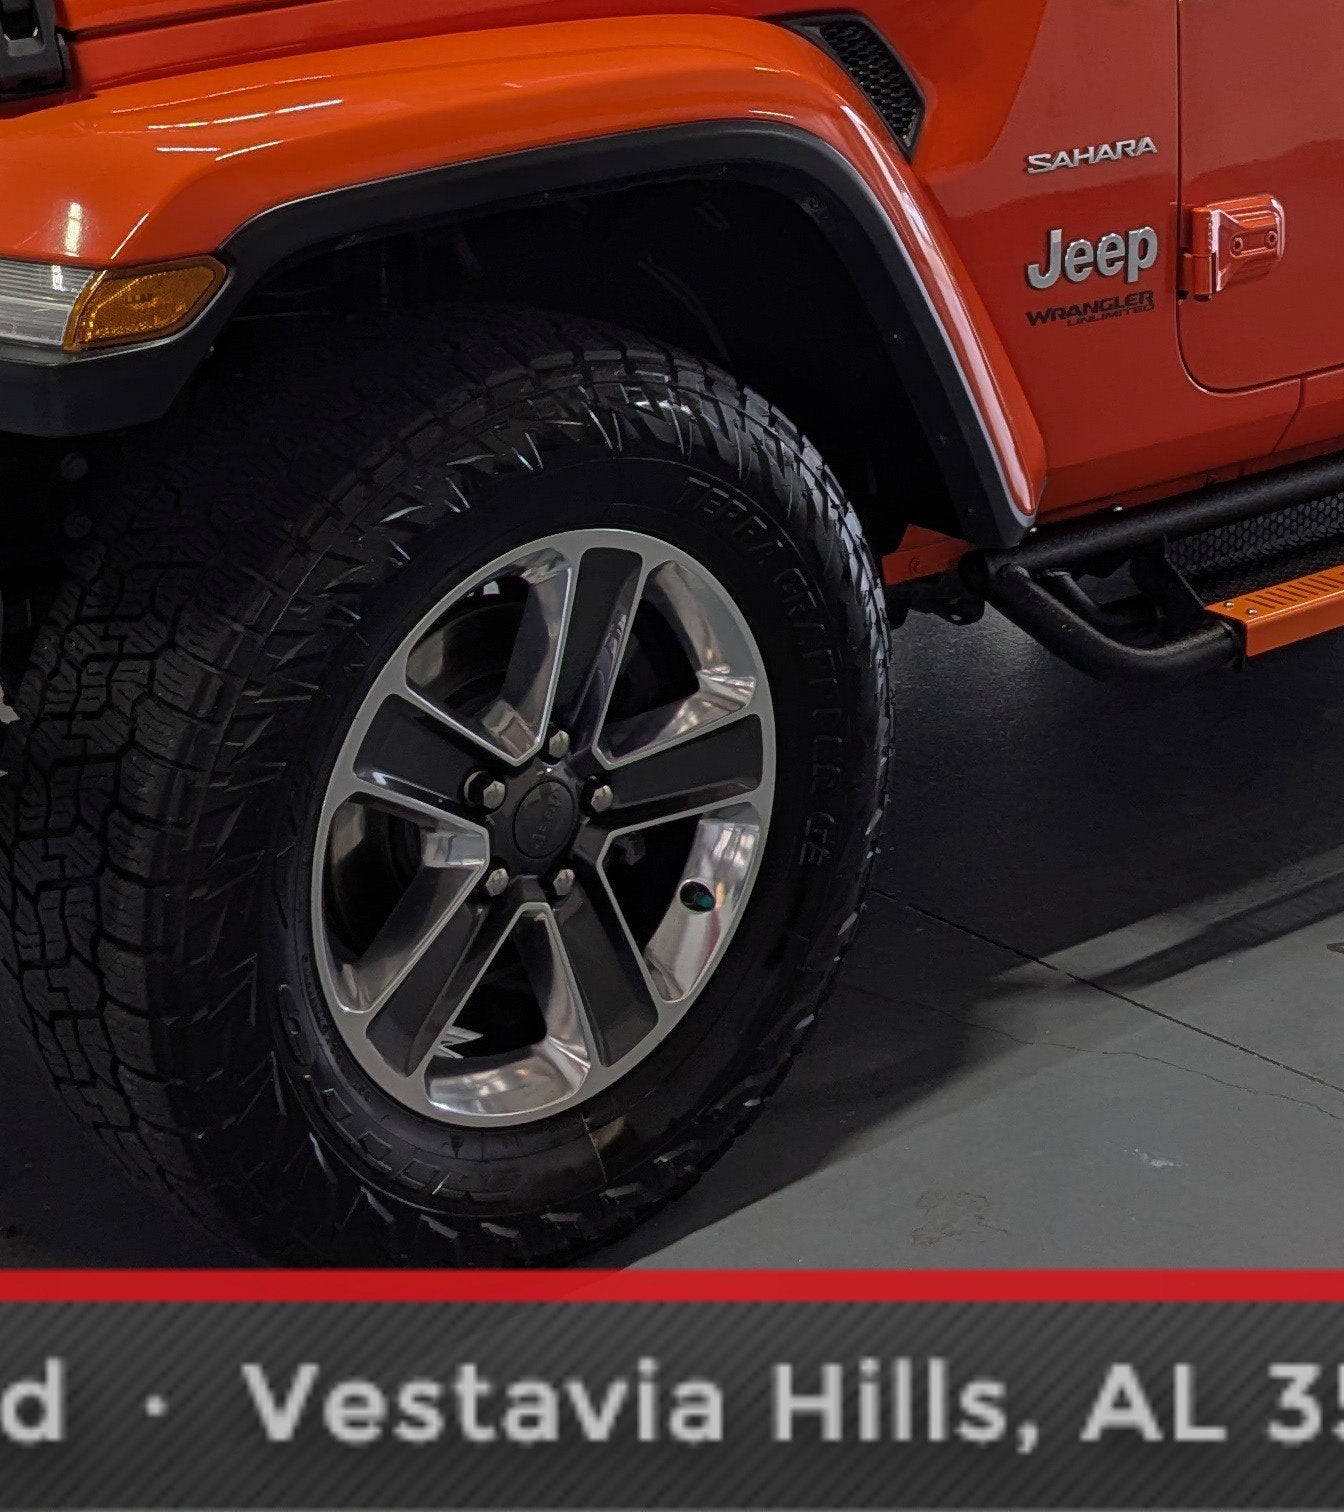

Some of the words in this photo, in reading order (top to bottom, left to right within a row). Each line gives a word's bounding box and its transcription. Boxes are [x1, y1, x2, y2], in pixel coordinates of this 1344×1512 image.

[1026, 136, 1158, 174] SAHARA
[1026, 226, 1158, 289] Jeep
[1025, 290, 1155, 326] WRANGLER
[1066, 303, 1155, 327] UNLIMITED
